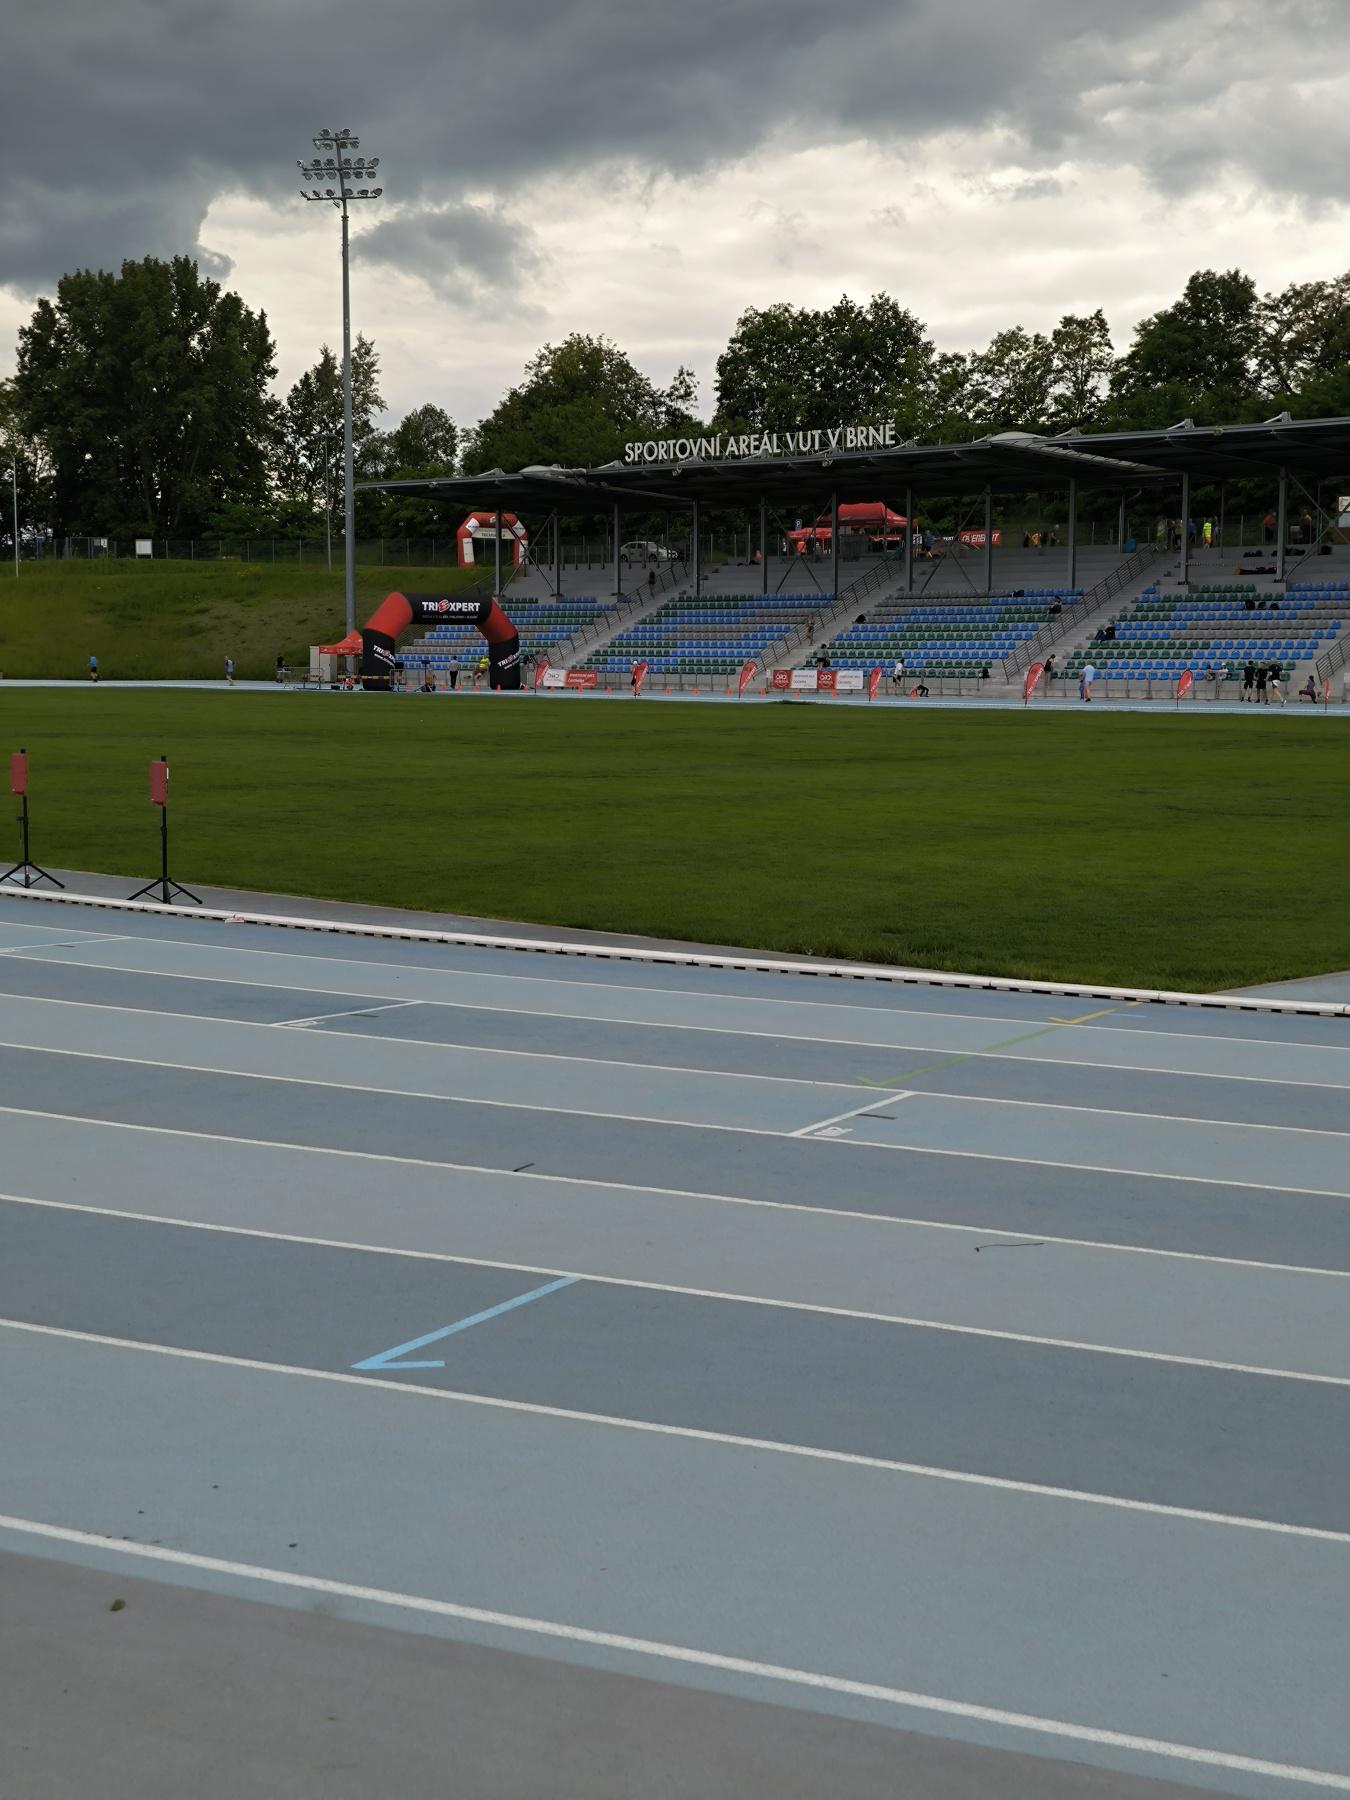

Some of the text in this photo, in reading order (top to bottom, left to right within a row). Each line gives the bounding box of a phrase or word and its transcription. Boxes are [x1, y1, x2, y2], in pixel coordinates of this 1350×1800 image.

[625, 420, 896, 463] SPORTOVNÍ AREÁL VUT V BRNĚ
